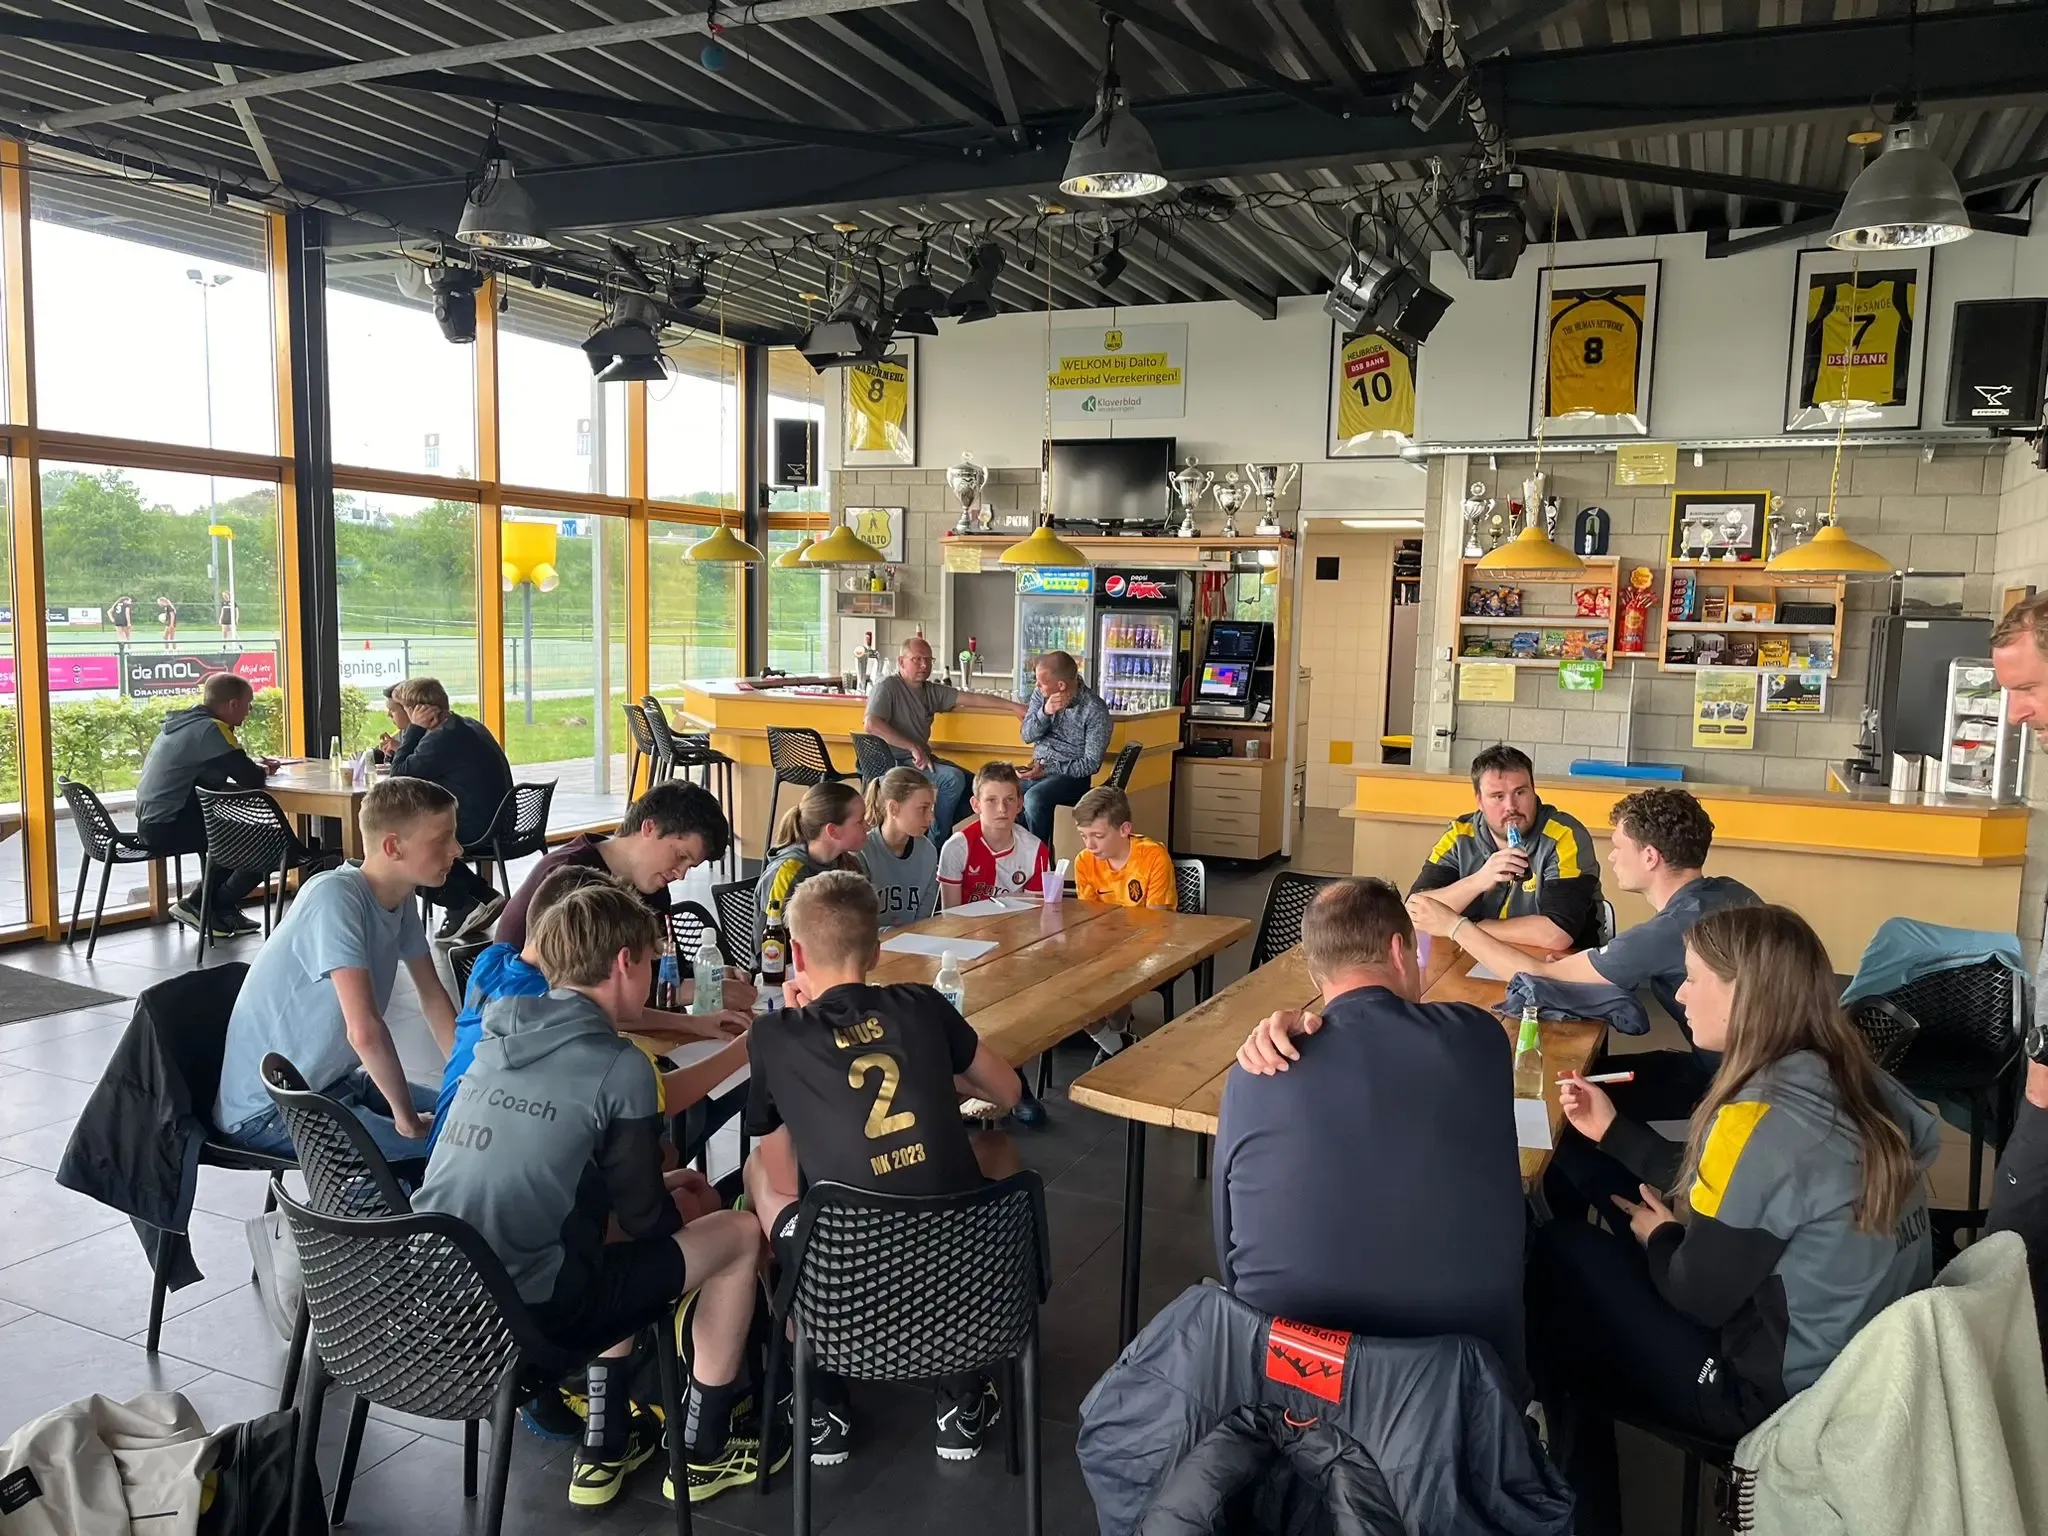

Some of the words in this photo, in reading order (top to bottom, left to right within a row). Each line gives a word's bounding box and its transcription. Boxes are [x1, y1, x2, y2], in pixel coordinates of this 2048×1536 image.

[1863, 299, 1891, 312] SANDE
[1563, 325, 1574, 336] THE
[1574, 320, 1596, 331] HUMAN
[1849, 314, 1876, 351] 7
[1584, 337, 1604, 365] 8
[1828, 354, 1849, 365] DSB
[1853, 353, 1886, 365] BANK
[1062, 358, 1112, 371] WELKOM
[1114, 358, 1127, 370] bij
[1129, 357, 1157, 368] Dalto
[1351, 361, 1365, 372] DSB
[1365, 356, 1385, 369] BANK
[1049, 374, 1101, 386] Klaverblad
[1102, 371, 1178, 383] Verzekeringen!
[1352, 371, 1393, 408] 10
[868, 378, 885, 403] 8
[1097, 397, 1142, 406] Klaverblad
[861, 535, 887, 545] DALTO
[1126, 581, 1166, 599] MAX
[132, 663, 152, 680] de
[340, 658, 401, 678] igning.nl
[878, 886, 920, 914] USA
[488, 1088, 557, 1122] Coach
[848, 1053, 916, 1140] 2
[870, 1153, 892, 1176] NK
[891, 1142, 927, 1170] 2023
[1895, 1204, 1927, 1252] DALTO
[1274, 1318, 1348, 1347] SUPERDRY
[1697, 1357, 1715, 1384] erima
